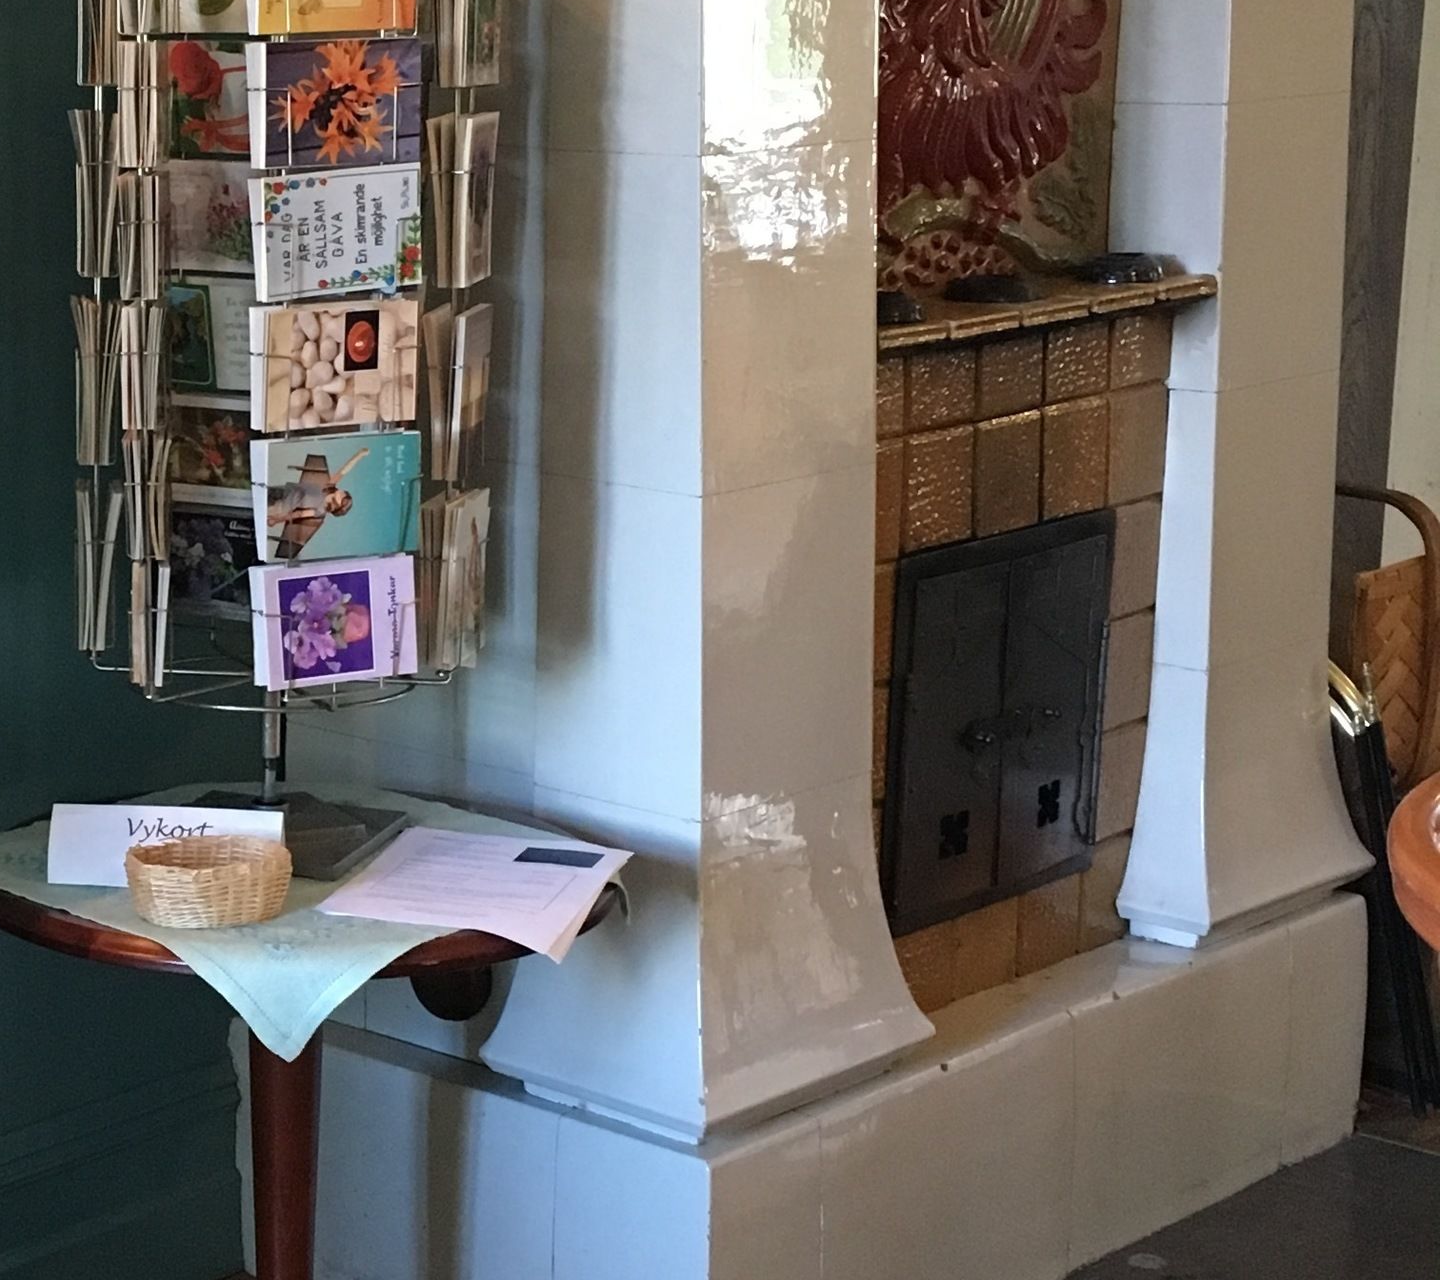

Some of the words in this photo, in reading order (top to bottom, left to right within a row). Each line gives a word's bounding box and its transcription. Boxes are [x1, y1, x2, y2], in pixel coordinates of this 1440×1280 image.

[298, 217, 309, 236] EN
[353, 184, 367, 244] skimrande
[281, 213, 293, 243] DAG
[355, 249, 368, 264] En
[127, 817, 214, 842] Vykort
